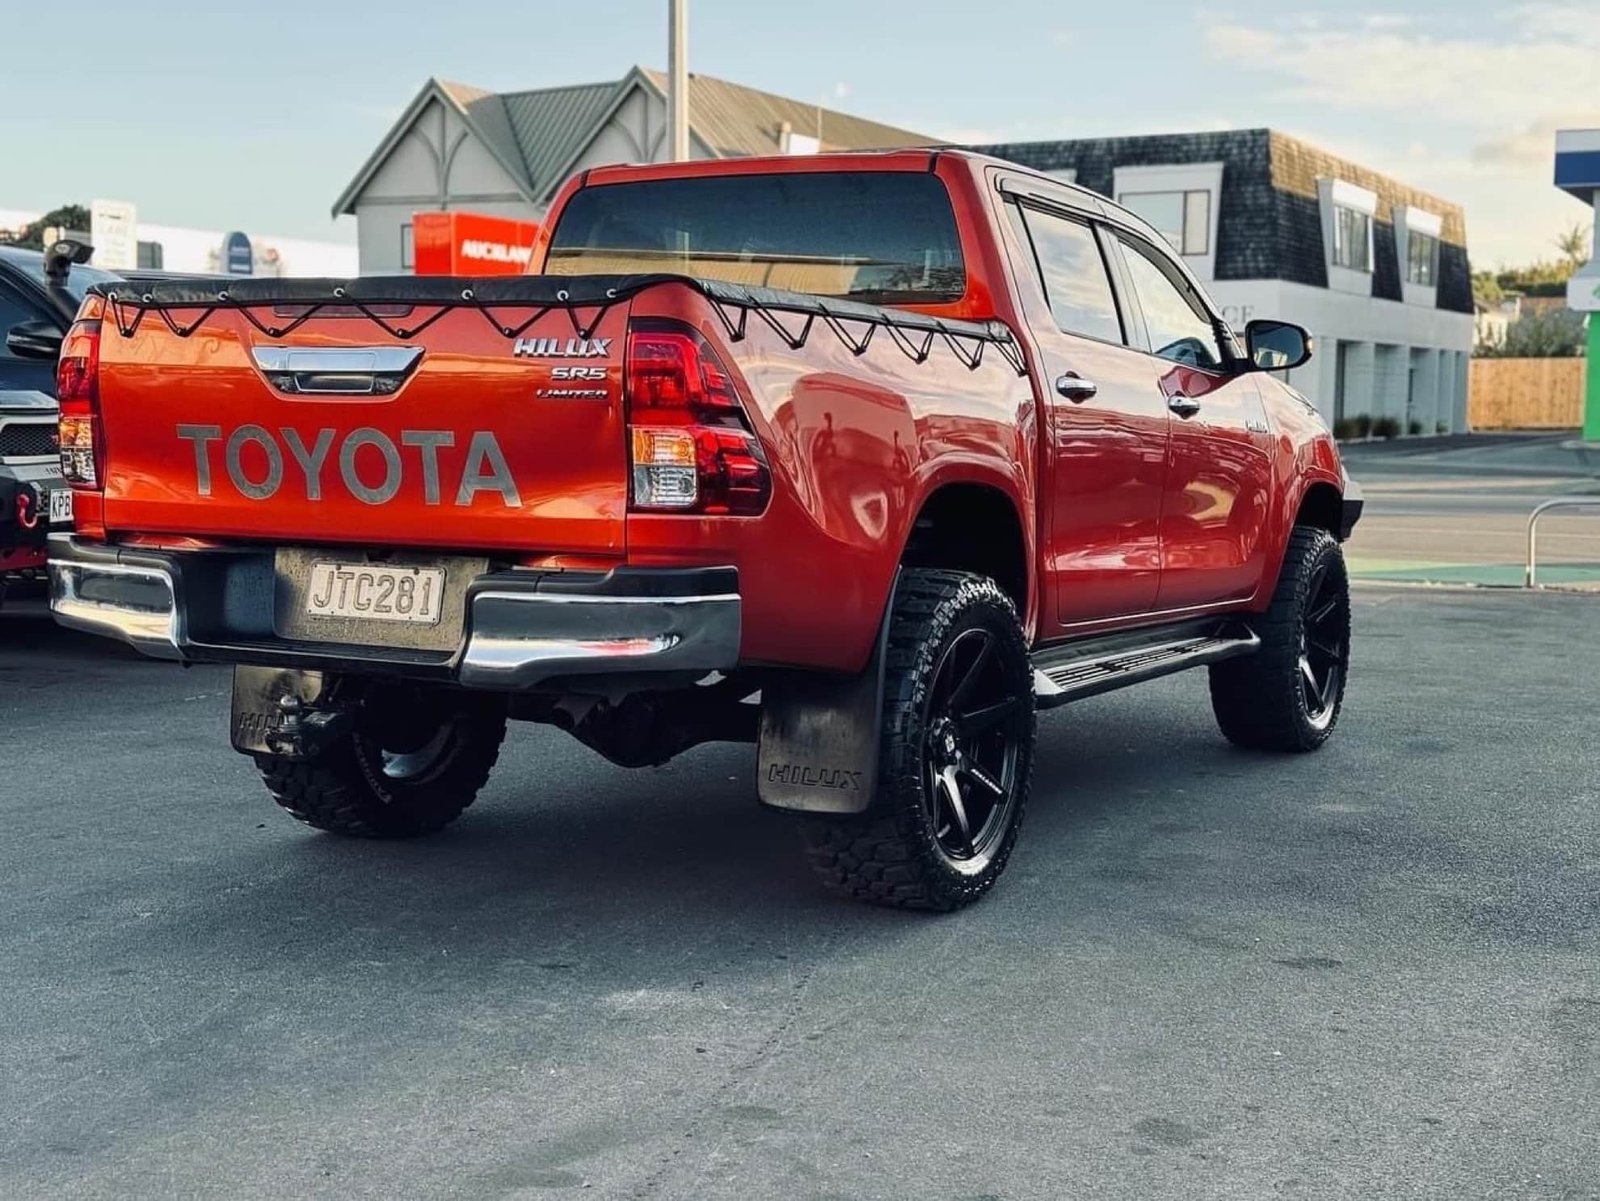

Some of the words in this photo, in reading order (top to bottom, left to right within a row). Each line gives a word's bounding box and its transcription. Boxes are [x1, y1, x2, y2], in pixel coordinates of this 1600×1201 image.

[461, 239, 532, 263] AUCKLAN
[514, 338, 612, 357] HILUX
[551, 367, 607, 380] SR5
[176, 424, 523, 508] TOYOTA
[52, 495, 71, 517] KPB
[313, 571, 432, 615] JTC281
[768, 763, 862, 790] HILUX
